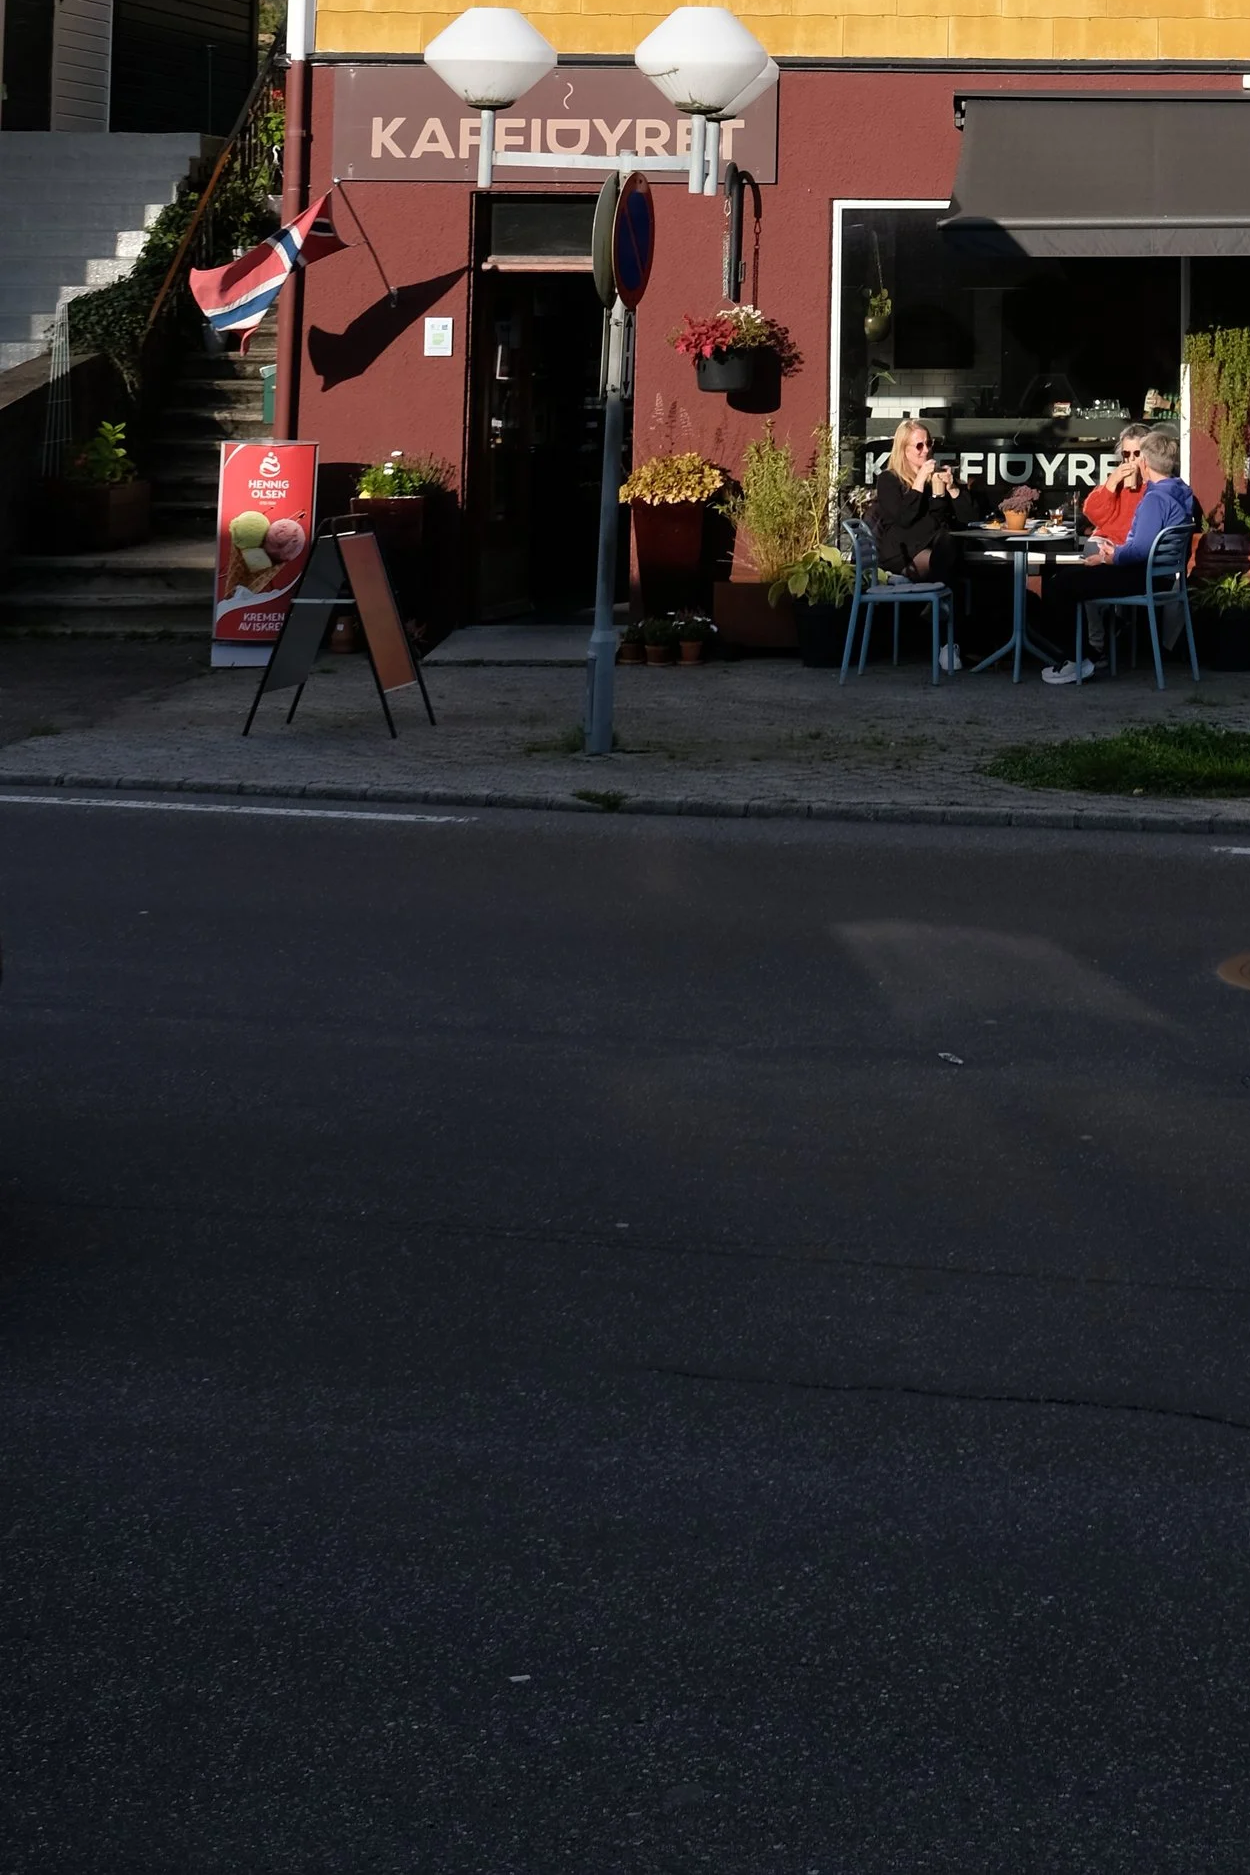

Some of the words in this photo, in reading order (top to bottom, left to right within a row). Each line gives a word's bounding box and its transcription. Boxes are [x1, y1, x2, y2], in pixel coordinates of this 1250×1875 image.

[248, 480, 289, 489] HENNIG
[251, 490, 286, 498] OLSEN
[243, 612, 285, 622] KREMEN
[252, 622, 283, 632] ISKRE
